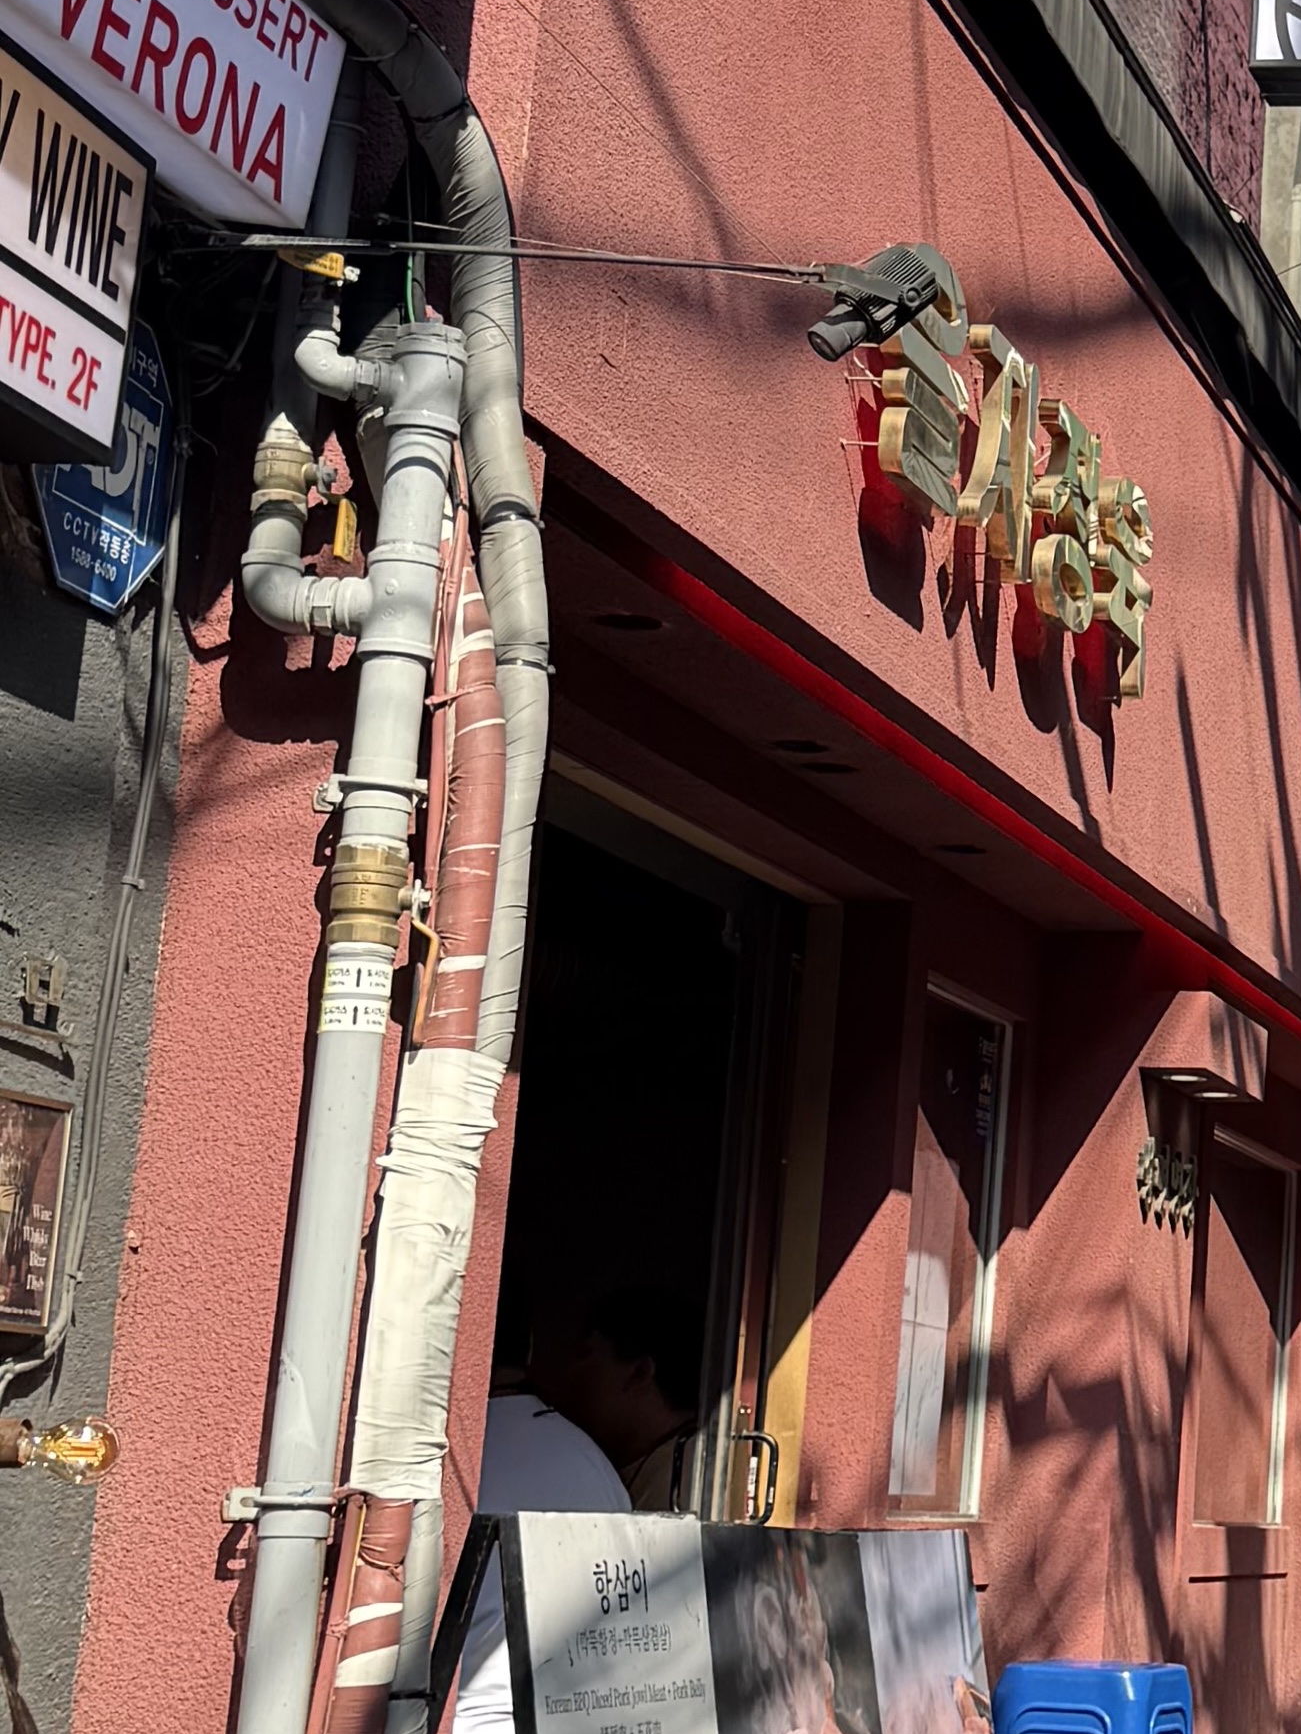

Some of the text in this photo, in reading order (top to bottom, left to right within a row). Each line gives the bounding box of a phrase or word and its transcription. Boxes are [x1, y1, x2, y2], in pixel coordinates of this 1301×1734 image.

[28, 107, 133, 302] WINE
[66, 346, 102, 412] 2F
[63, 511, 99, 545] CCTV
[592, 1558, 649, 1615] 항삼이
[545, 1695, 571, 1715] Korean
